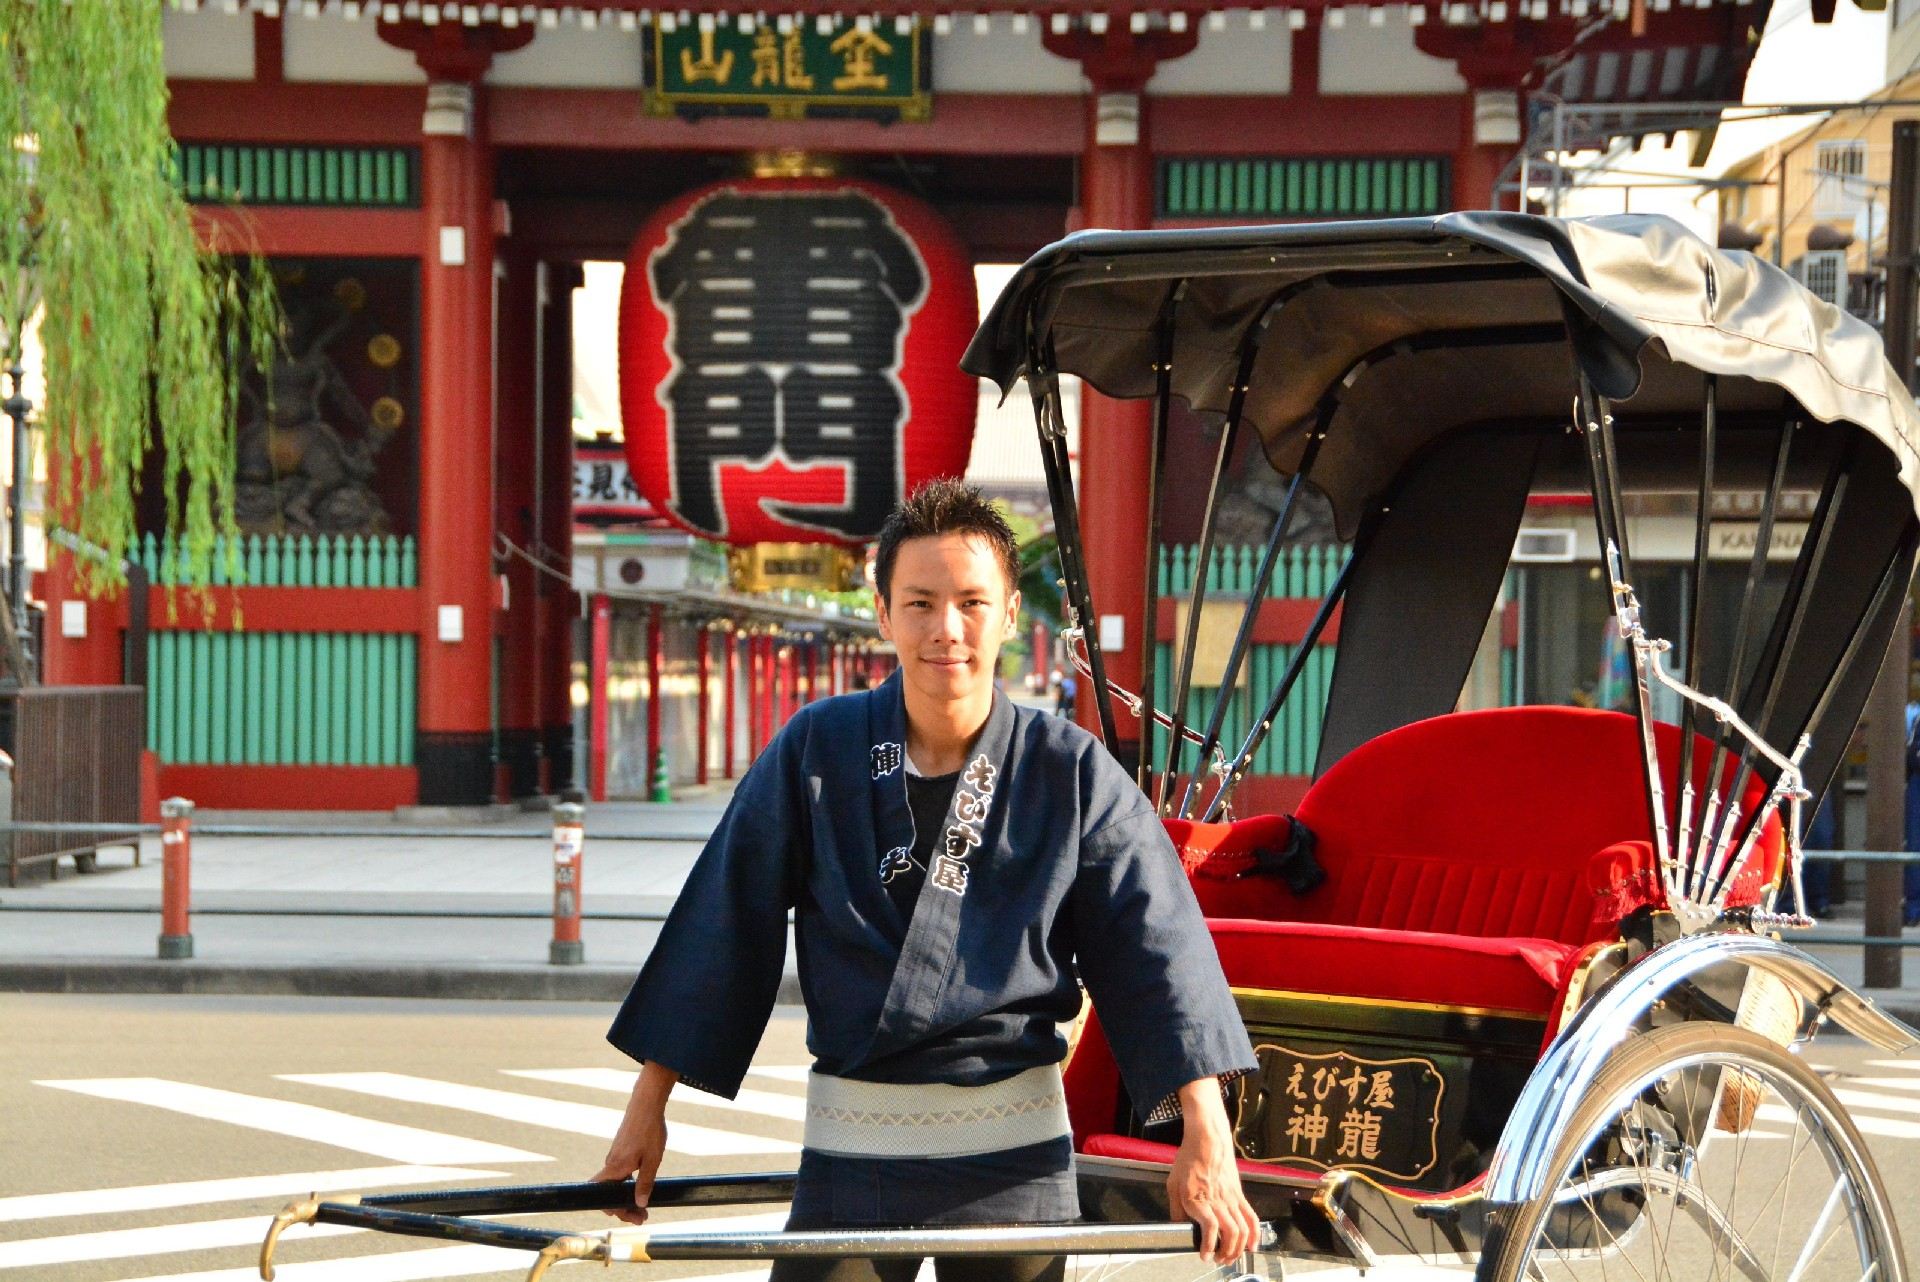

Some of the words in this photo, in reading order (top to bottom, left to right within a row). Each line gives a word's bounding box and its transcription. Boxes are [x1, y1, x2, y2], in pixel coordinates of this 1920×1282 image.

[648, 187, 930, 538] 雷門
[932, 754, 997, 896] えびす屋
[1285, 1104, 1383, 1160] 神龍
[1286, 1062, 1395, 1109] えびす屋
